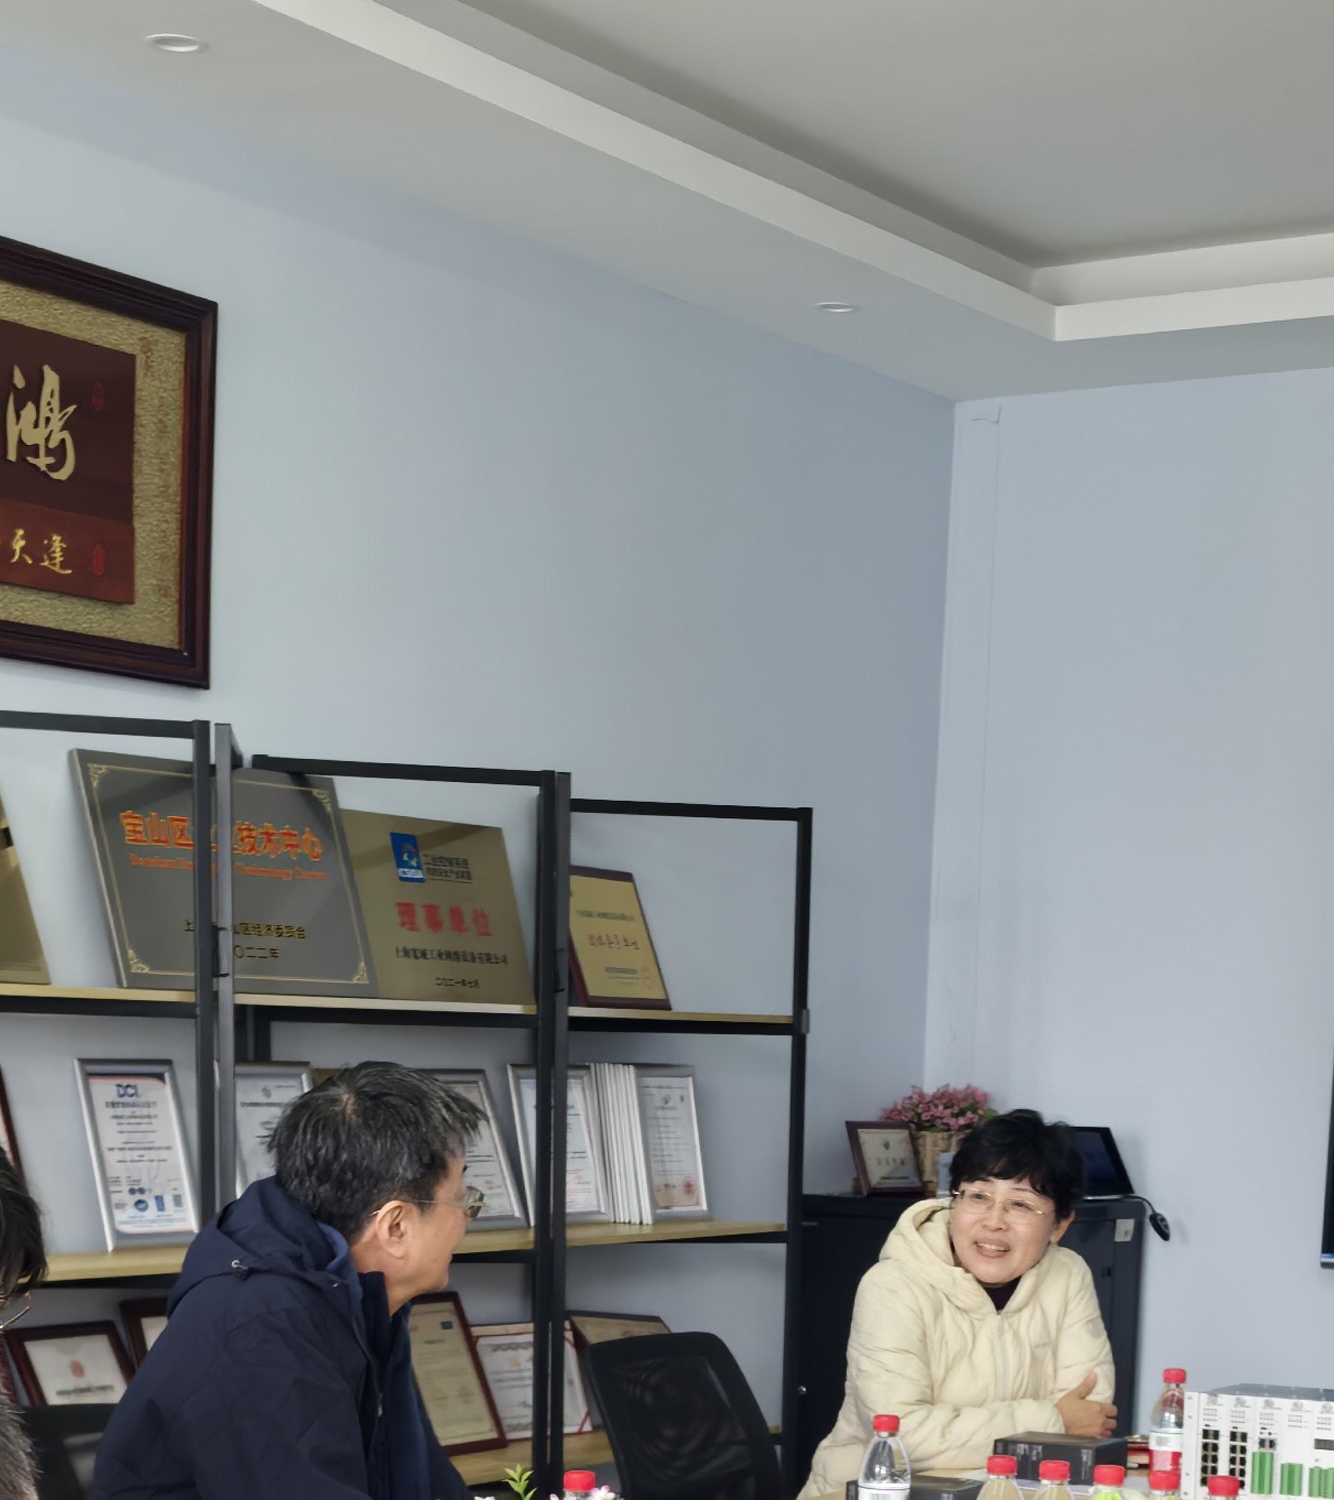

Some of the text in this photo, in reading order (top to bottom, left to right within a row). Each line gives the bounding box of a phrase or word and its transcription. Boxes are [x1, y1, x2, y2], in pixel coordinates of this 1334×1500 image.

[119, 809, 324, 862] 宝山区技术中心
